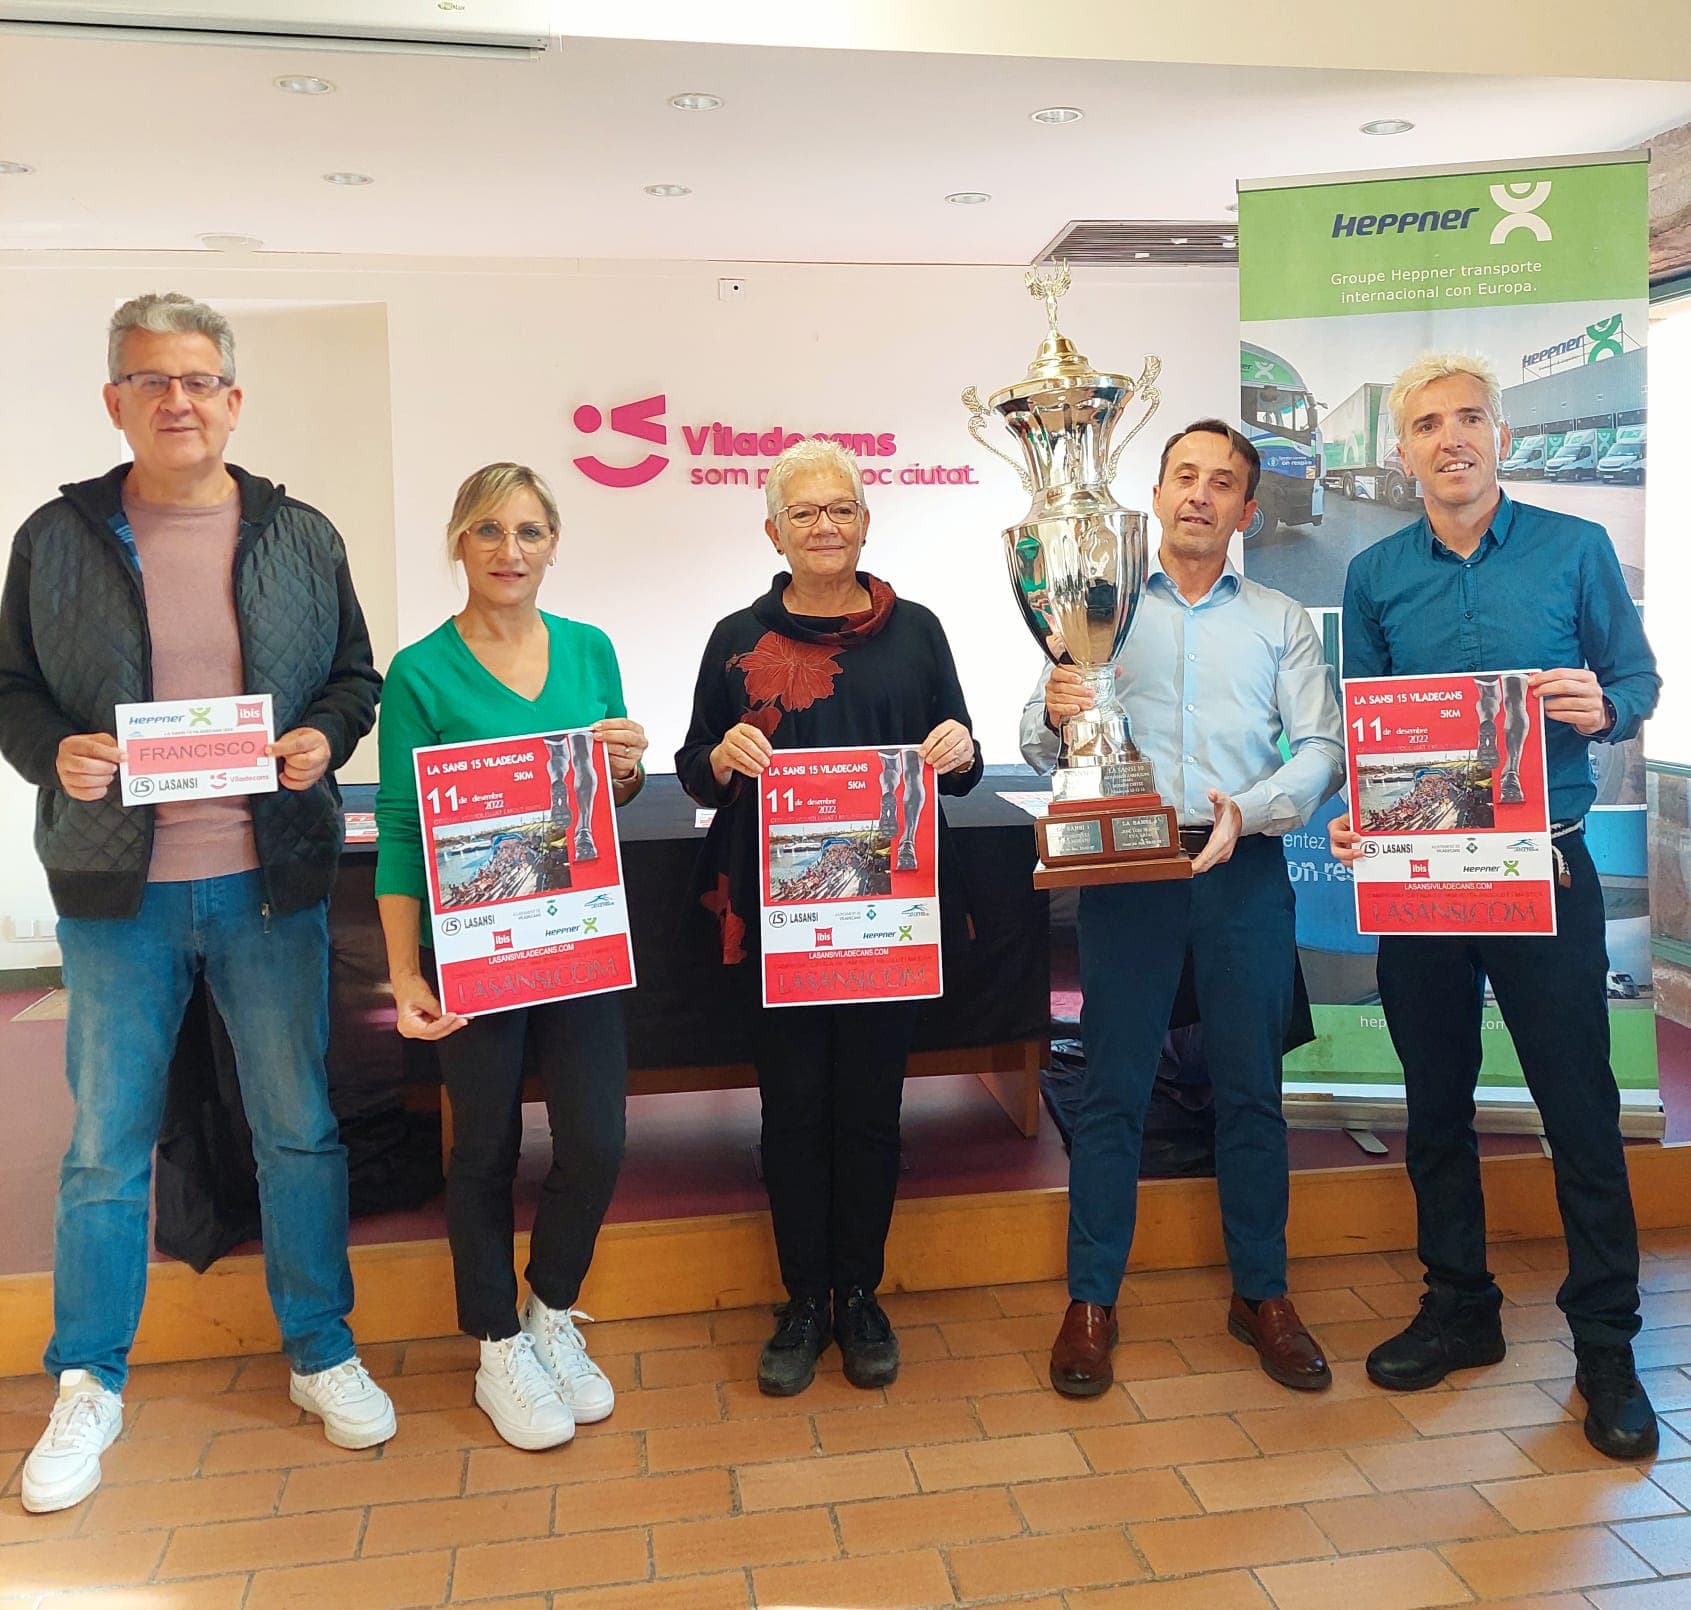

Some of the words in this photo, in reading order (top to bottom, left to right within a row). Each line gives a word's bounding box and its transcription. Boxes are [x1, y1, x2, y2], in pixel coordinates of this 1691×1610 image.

[1331, 207, 1480, 238] Heppner
[1331, 272, 1386, 287] Groupe
[1391, 266, 1456, 284] Heppner
[1461, 260, 1543, 279] transporte
[1341, 286, 1439, 304] internacional
[1445, 283, 1472, 297] con
[1478, 281, 1538, 298] Europa.
[1522, 334, 1586, 368] Heppner
[682, 422, 897, 456] Viladns
[690, 467, 748, 485] som
[900, 463, 979, 485] ciutat.
[1354, 695, 1367, 706] LA
[1368, 694, 1394, 705] SANSI
[1396, 693, 1408, 703] 15
[1409, 690, 1463, 702] VILADECANS
[129, 714, 185, 725] Heppner
[239, 707, 261, 719] ibis
[1440, 709, 1461, 719] 5KM
[1351, 716, 1382, 743] 11
[1408, 734, 1429, 744] 2022
[140, 741, 255, 762] FRANCISCO
[427, 765, 440, 776] LA
[442, 761, 468, 774] SANSI
[471, 759, 481, 770] 15
[483, 752, 535, 768] VILADECANS
[769, 767, 780, 776] LA
[782, 765, 805, 776] SANSI
[809, 765, 818, 775] 15
[820, 763, 868, 774] VILADECANS
[513, 771, 534, 782] 5KM
[134, 779, 150, 793] LS
[158, 777, 198, 791] LASANSI
[848, 780, 866, 790] 5KM
[426, 785, 458, 814] 11
[484, 800, 504, 810] 2022
[766, 787, 794, 813] 11
[818, 805, 837, 814] 2022
[1382, 843, 1413, 854] LASANSI
[1412, 863, 1427, 873] ibis
[1462, 865, 1501, 874] Heppner
[1404, 882, 1493, 891] LASANSIVILADECANS.COM
[464, 914, 496, 929] LASANSI
[790, 912, 819, 924] LASANSI
[495, 934, 511, 945] ibis
[545, 925, 581, 937] Heppner
[816, 932, 831, 942] ibis
[863, 931, 897, 940] Heppner
[488, 943, 575, 965] LASANSIVILADECANS.COM
[808, 948, 889, 960] LASANSIVILADECANS.COM
